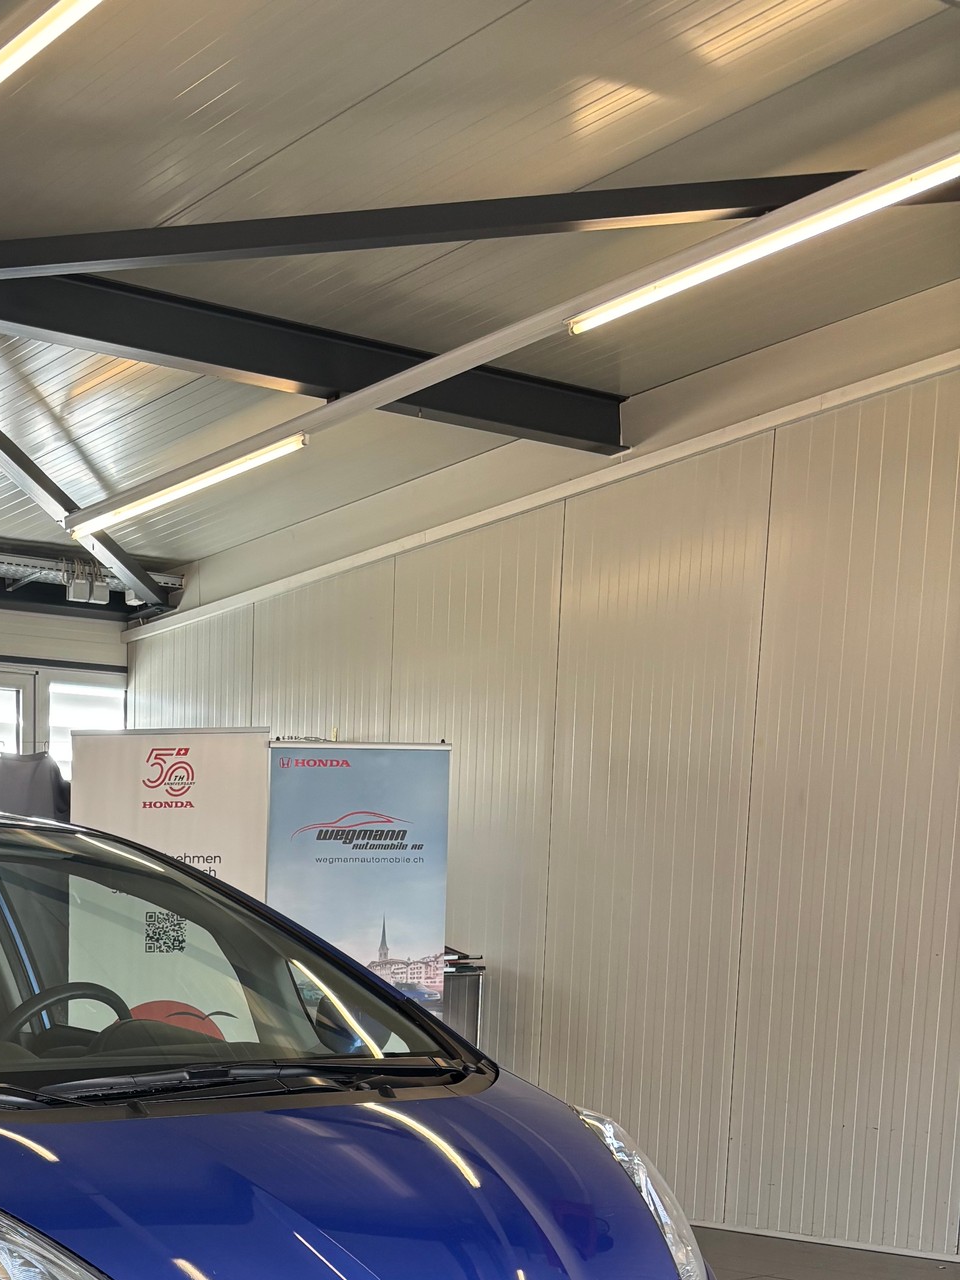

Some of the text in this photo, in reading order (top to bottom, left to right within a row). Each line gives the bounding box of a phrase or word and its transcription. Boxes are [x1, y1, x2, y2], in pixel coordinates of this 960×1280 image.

[294, 758, 351, 768] HONDA
[142, 748, 195, 797] 50
[142, 800, 195, 809] HONDA
[316, 829, 408, 845] wegmann
[315, 856, 425, 864] wegmannautomobile.ch
